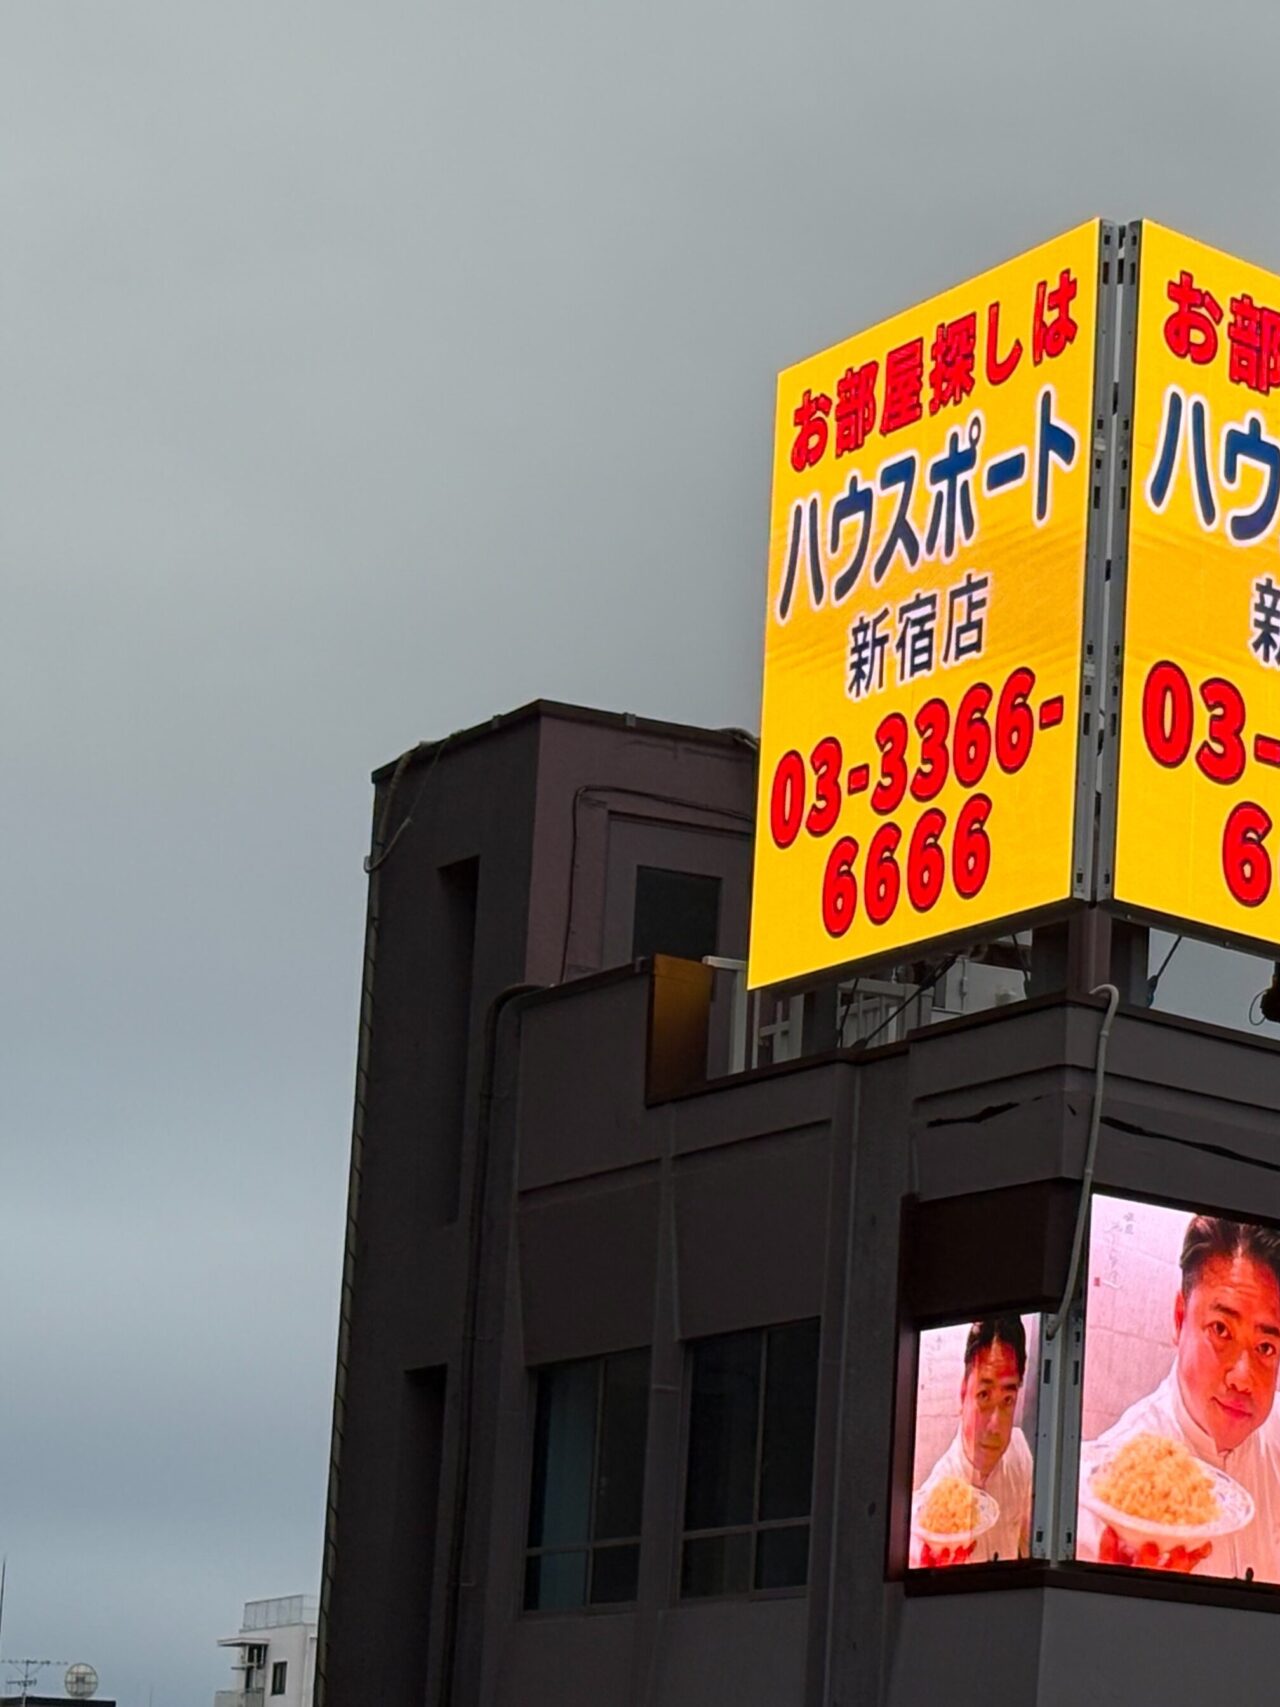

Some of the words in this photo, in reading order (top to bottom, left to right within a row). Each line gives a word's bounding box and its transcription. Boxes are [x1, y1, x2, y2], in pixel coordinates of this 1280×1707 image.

[791, 268, 1078, 473] お部屋探しは
[778, 389, 1076, 619] ハウスポート
[848, 574, 989, 698] 新宿店
[769, 666, 1065, 849] 03-3366-
[821, 793, 993, 938] 6666
